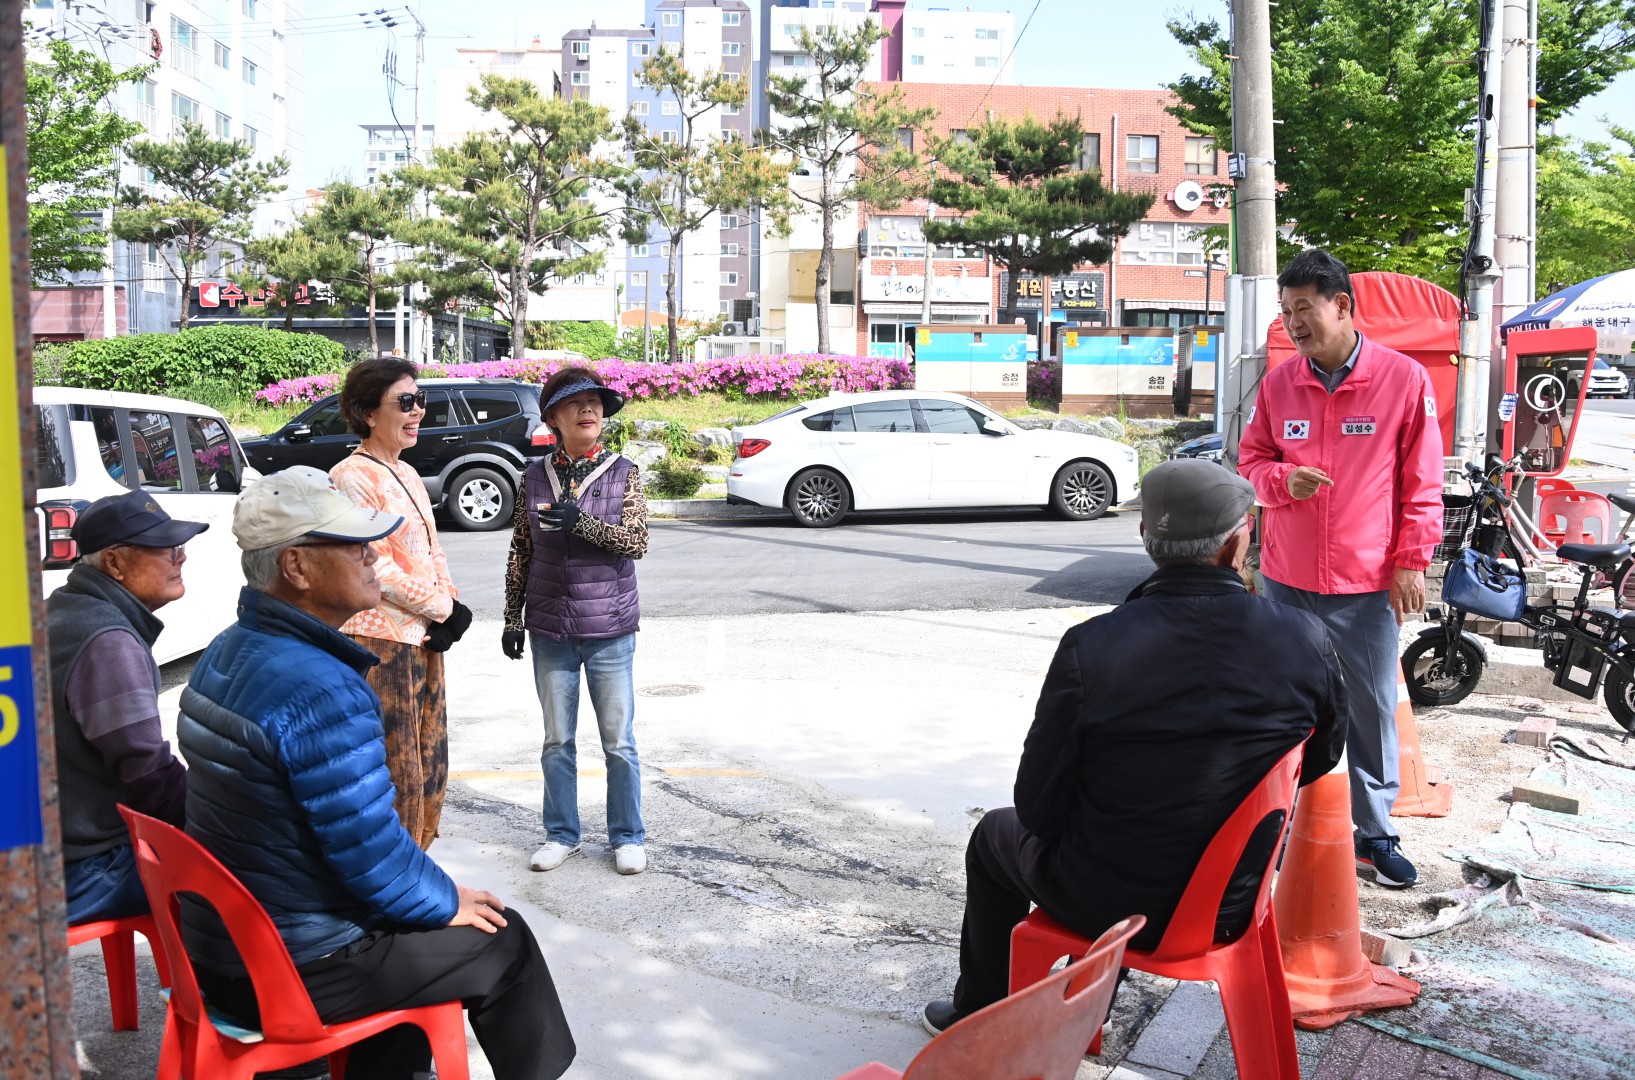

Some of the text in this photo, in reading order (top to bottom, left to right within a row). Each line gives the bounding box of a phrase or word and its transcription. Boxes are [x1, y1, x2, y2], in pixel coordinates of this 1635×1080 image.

[1582, 317, 1631, 327] 해운대구
[1001, 372, 1019, 382] 송정
[1148, 375, 1165, 385] 송정
[1346, 424, 1372, 433] 김성수
